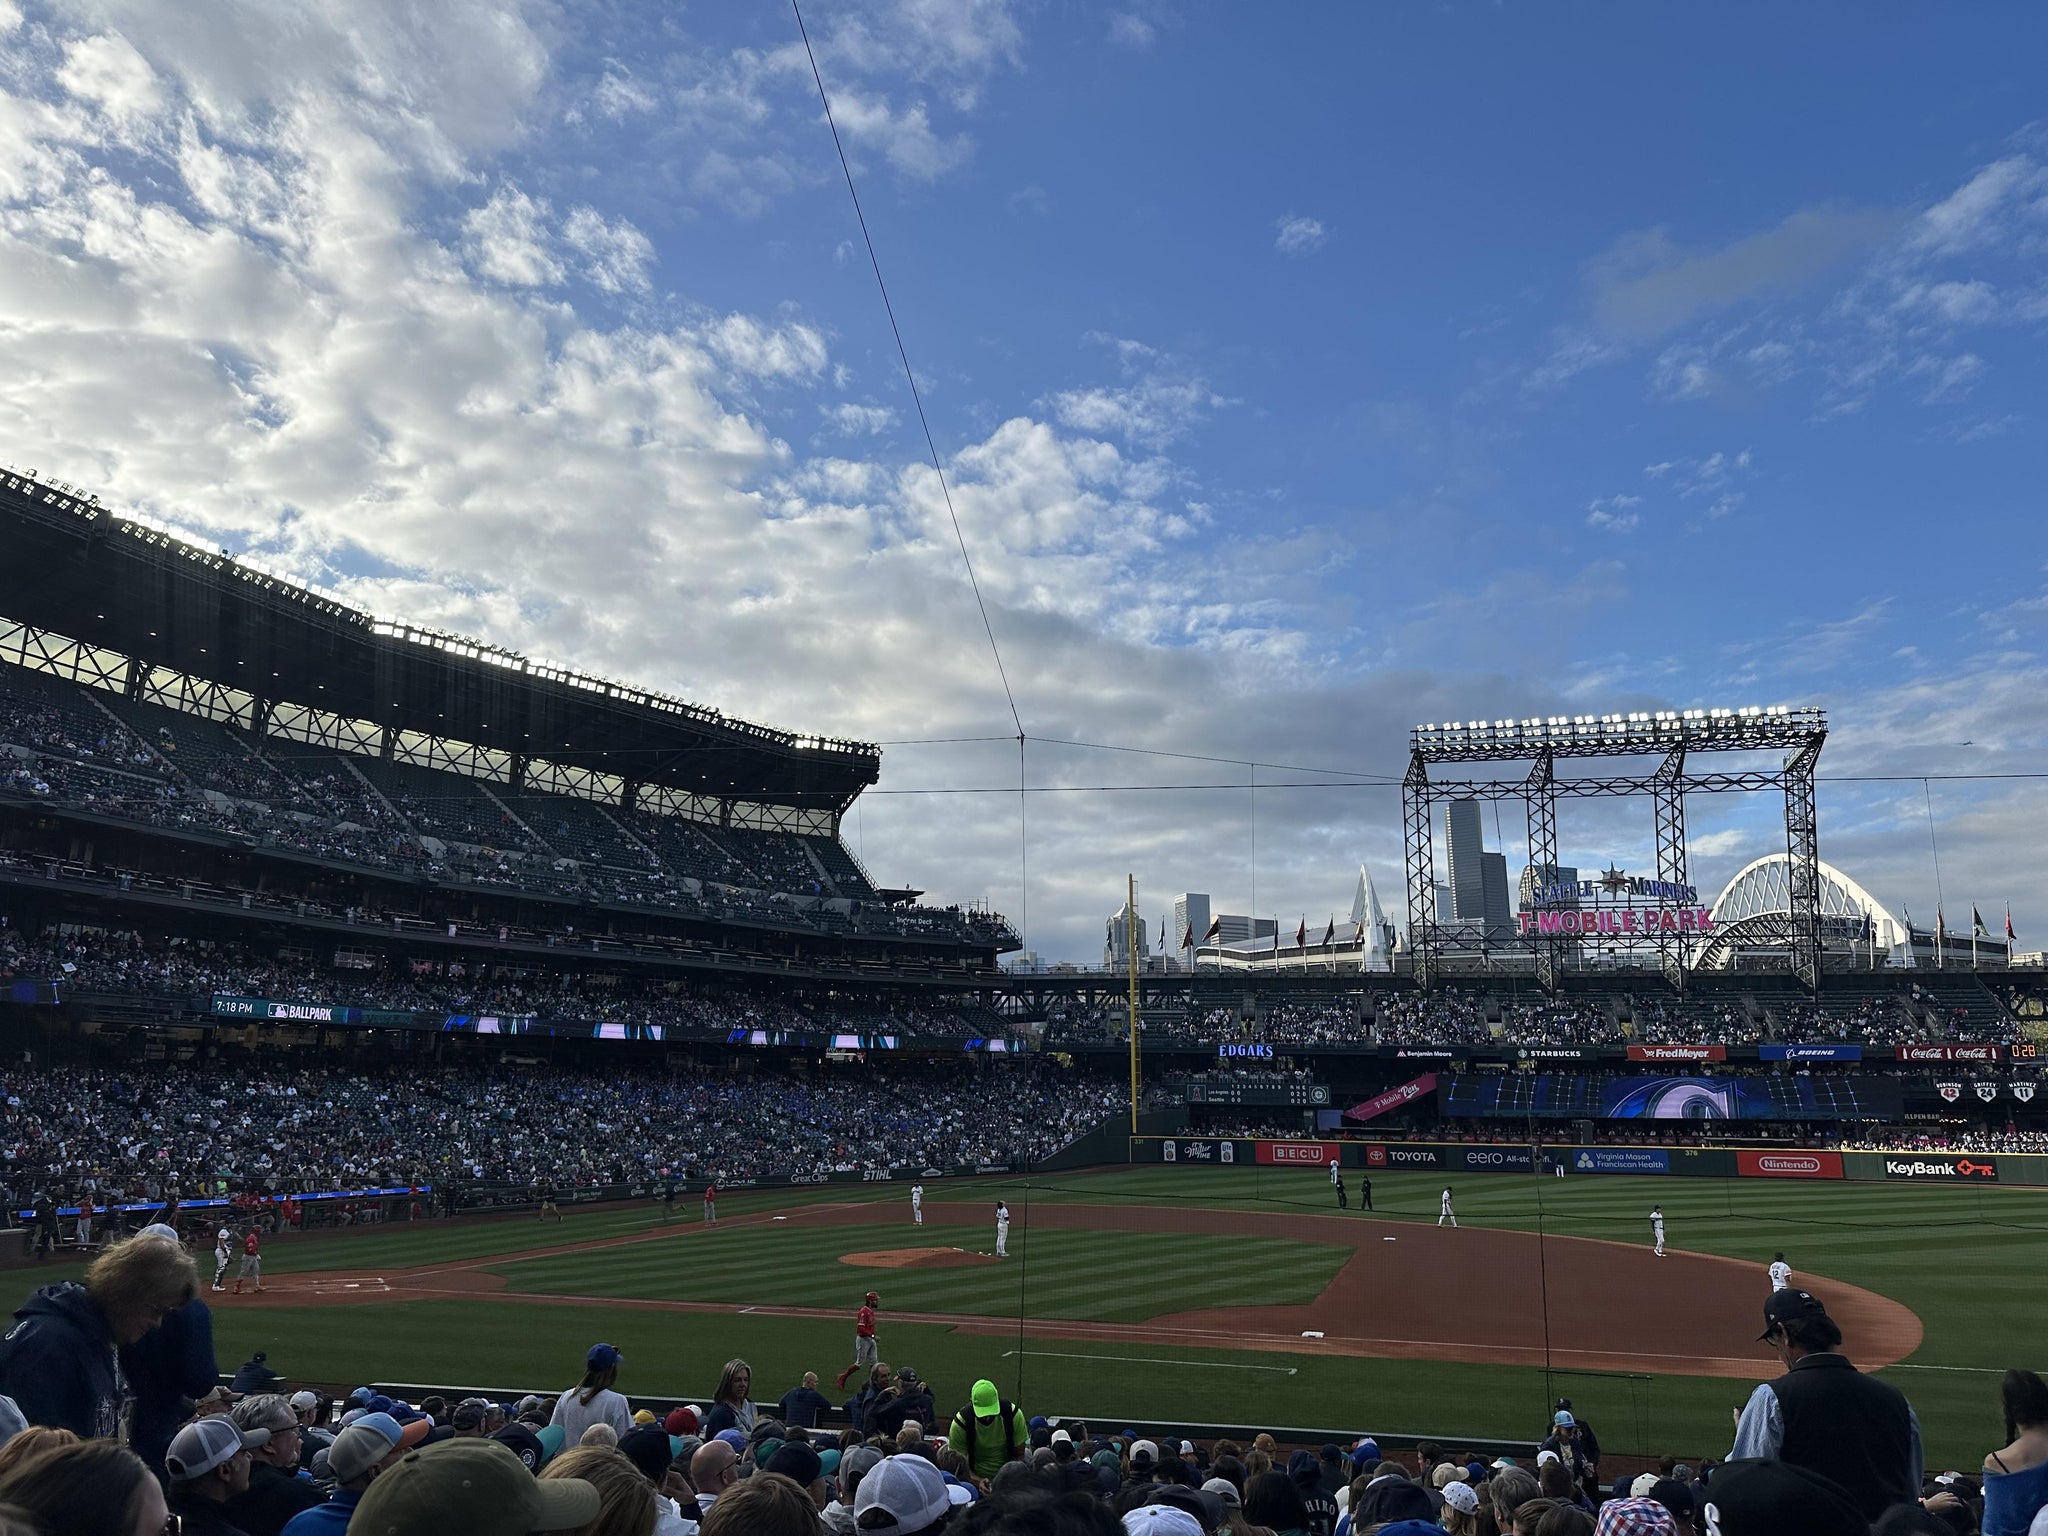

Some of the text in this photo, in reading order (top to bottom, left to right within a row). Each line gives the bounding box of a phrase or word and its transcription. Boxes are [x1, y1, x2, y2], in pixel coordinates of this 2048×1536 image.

[1532, 877, 1697, 904] SEATTLE MARINERS
[1517, 909, 1715, 934] T-MOBILE PARK
[216, 1000, 253, 1014] 7:18 PM
[289, 1006, 331, 1021] BALLPARK
[1407, 1050, 1434, 1058] Benjamin
[2011, 1044, 2036, 1057] 0:28
[1400, 1083, 1420, 1099] Pen
[1943, 1089, 1957, 1098] 42
[1980, 1089, 1994, 1098] 24
[2019, 1089, 2029, 1098] 11
[1184, 1144, 1212, 1158] Miller
[1390, 1151, 1436, 1162] TOYOTA
[1596, 1152, 1651, 1162] Virginia Mason
[1467, 1152, 1503, 1164] eero
[1597, 1160, 1664, 1169] Franciscan Health
[1763, 1159, 1815, 1170] Nintendo
[1886, 1160, 1955, 1176] KeyBank
[790, 1172, 829, 1184] Great Clips
[863, 1169, 892, 1181] STIHL
[1772, 1270, 1779, 1279] 12
